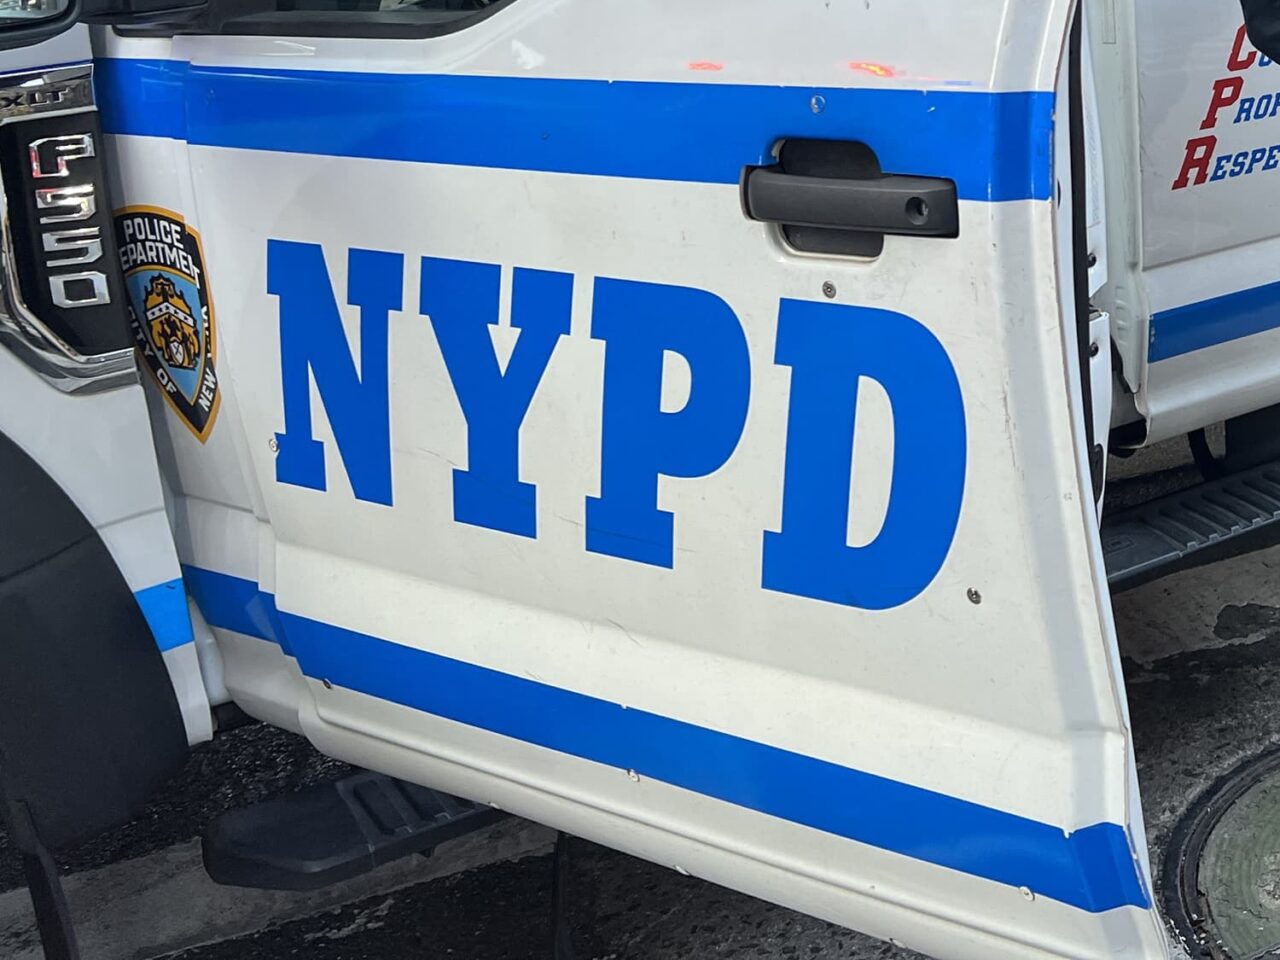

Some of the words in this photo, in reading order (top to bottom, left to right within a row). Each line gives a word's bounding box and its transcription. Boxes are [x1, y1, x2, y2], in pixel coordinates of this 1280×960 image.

[0, 87, 70, 111] XLT
[123, 218, 184, 249] POLICE
[157, 368, 177, 393] OF
[199, 367, 217, 412] NEW
[267, 238, 967, 611] NYPD
